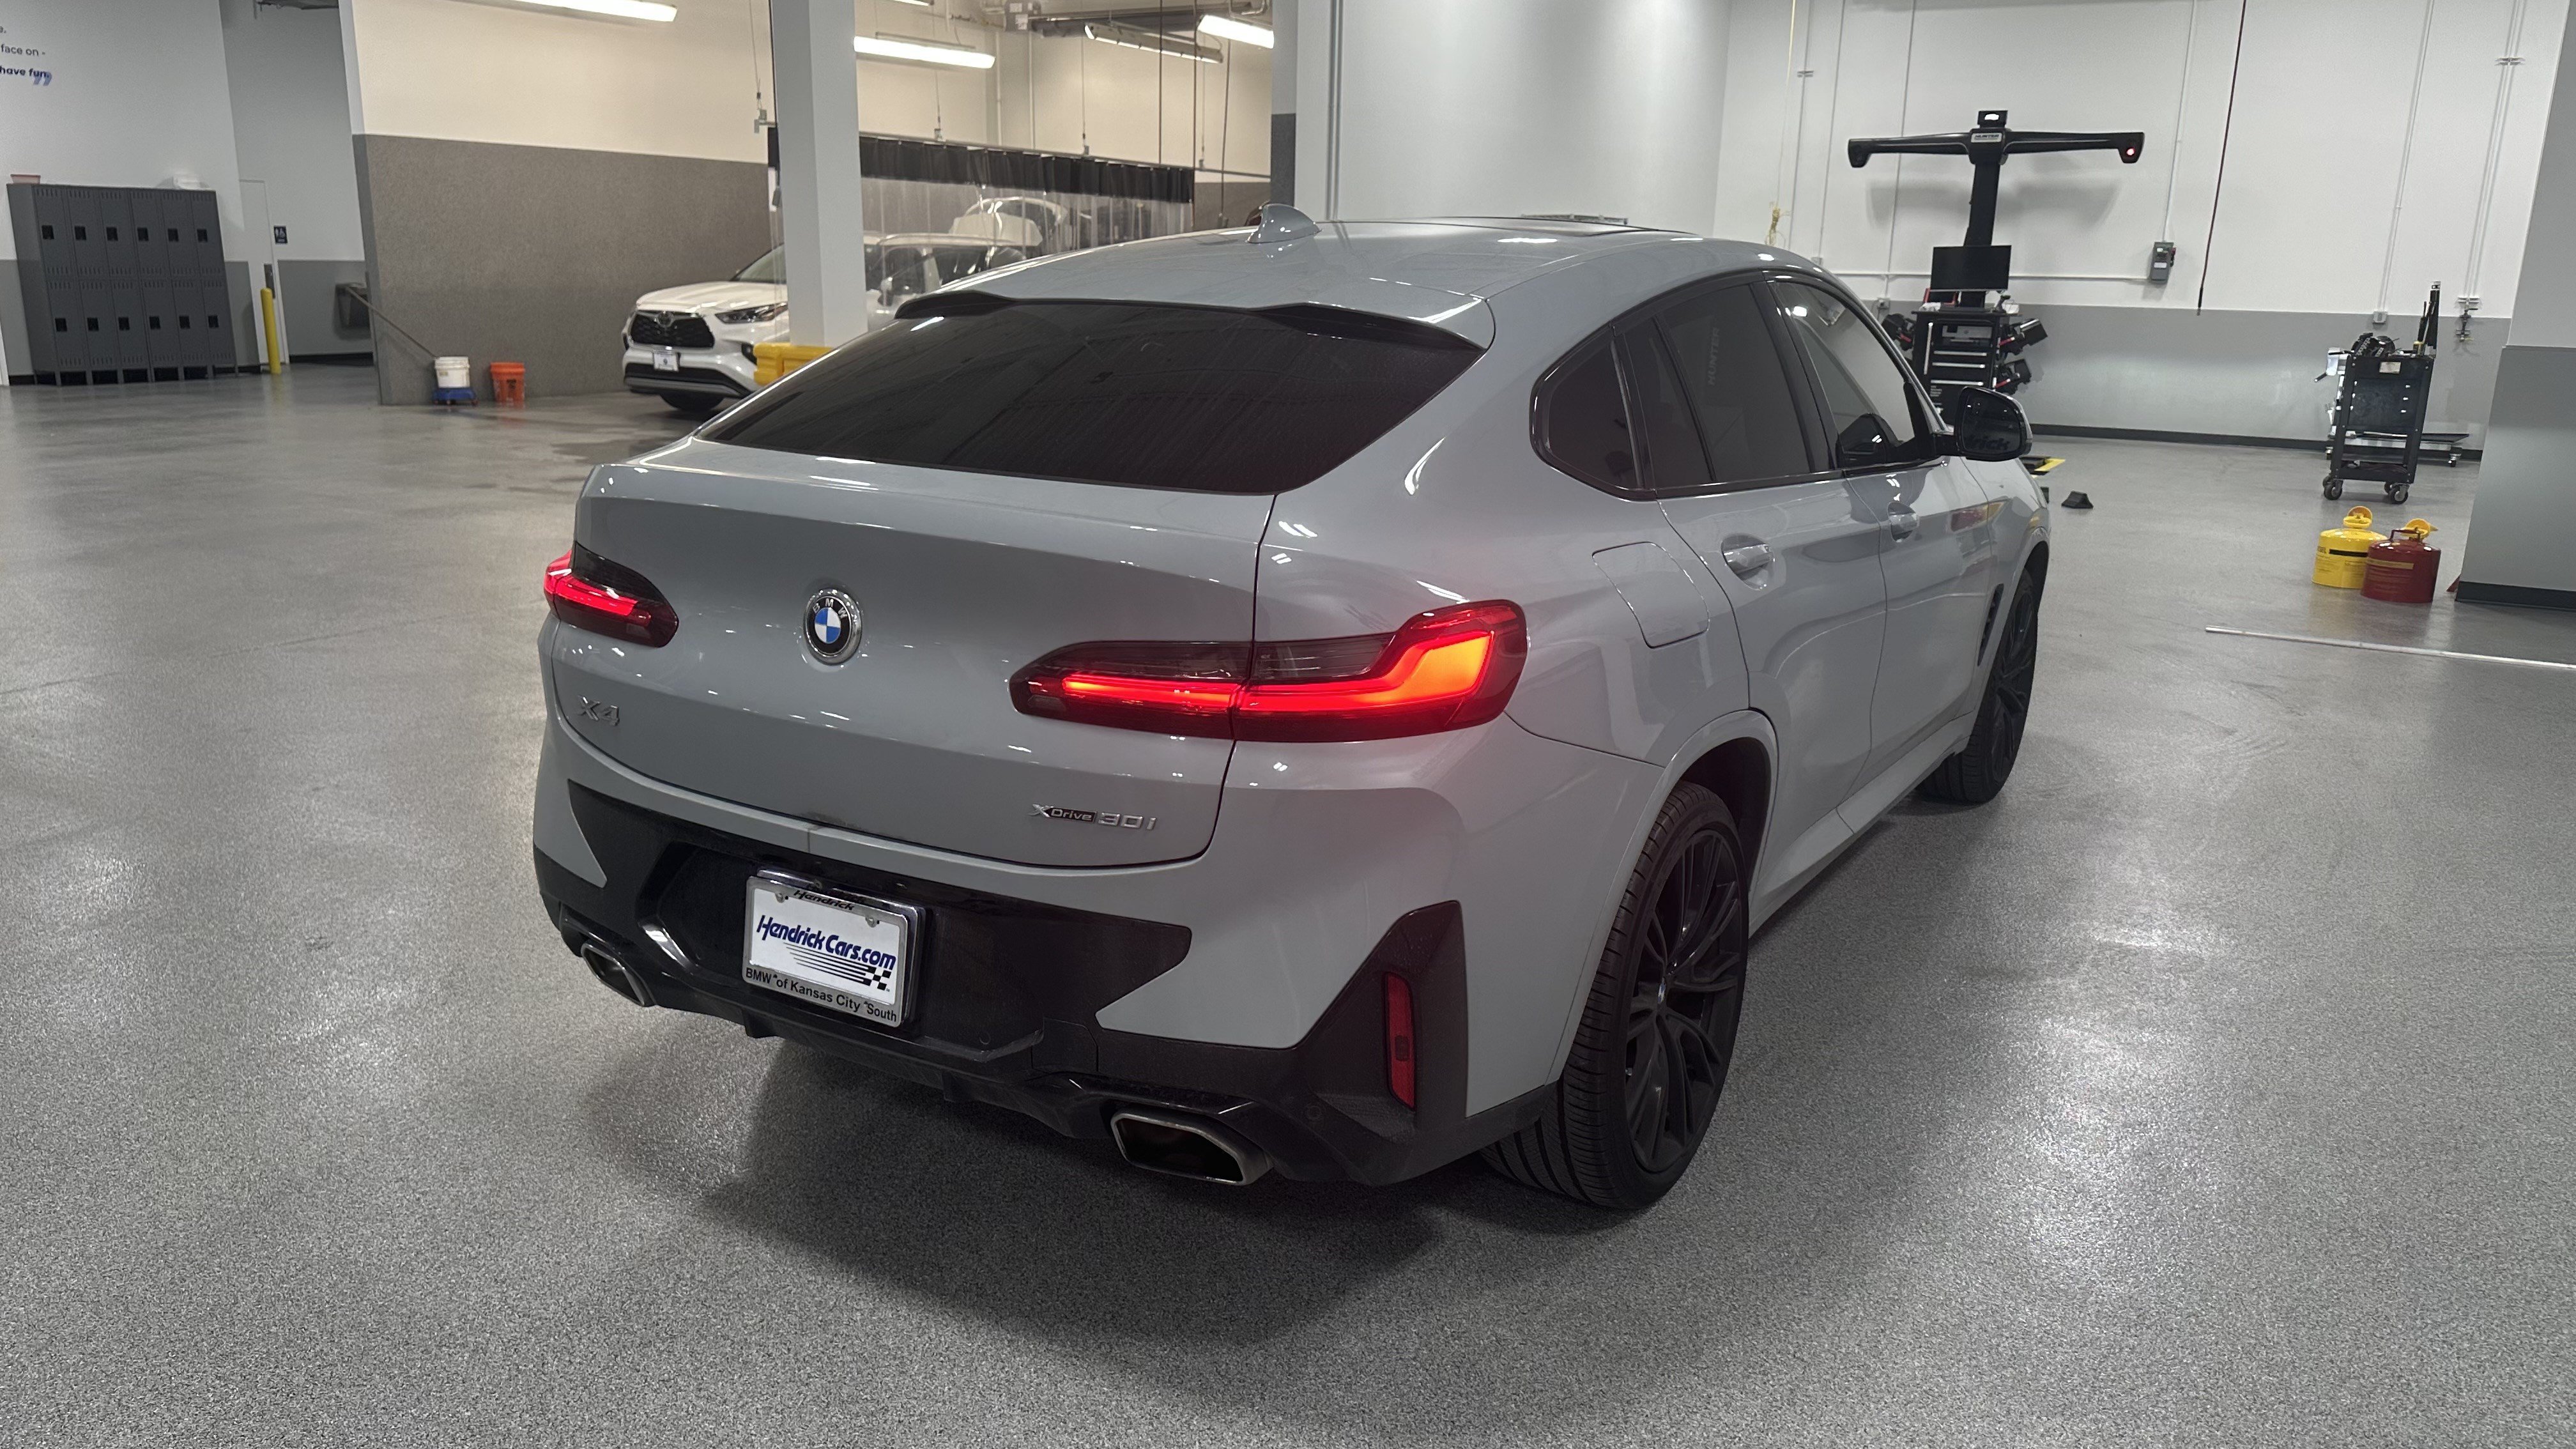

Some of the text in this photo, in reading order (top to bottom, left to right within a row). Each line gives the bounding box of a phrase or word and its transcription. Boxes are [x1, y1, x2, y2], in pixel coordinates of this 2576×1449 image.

[1, 43, 23, 55] face
[0, 65, 26, 76] have
[1707, 326, 1721, 386] HUNTER
[813, 597, 848, 619] BMW
[576, 694, 620, 726] X4
[793, 890, 855, 910] Hendrick
[746, 967, 897, 1022] BMW of Kansas City South
